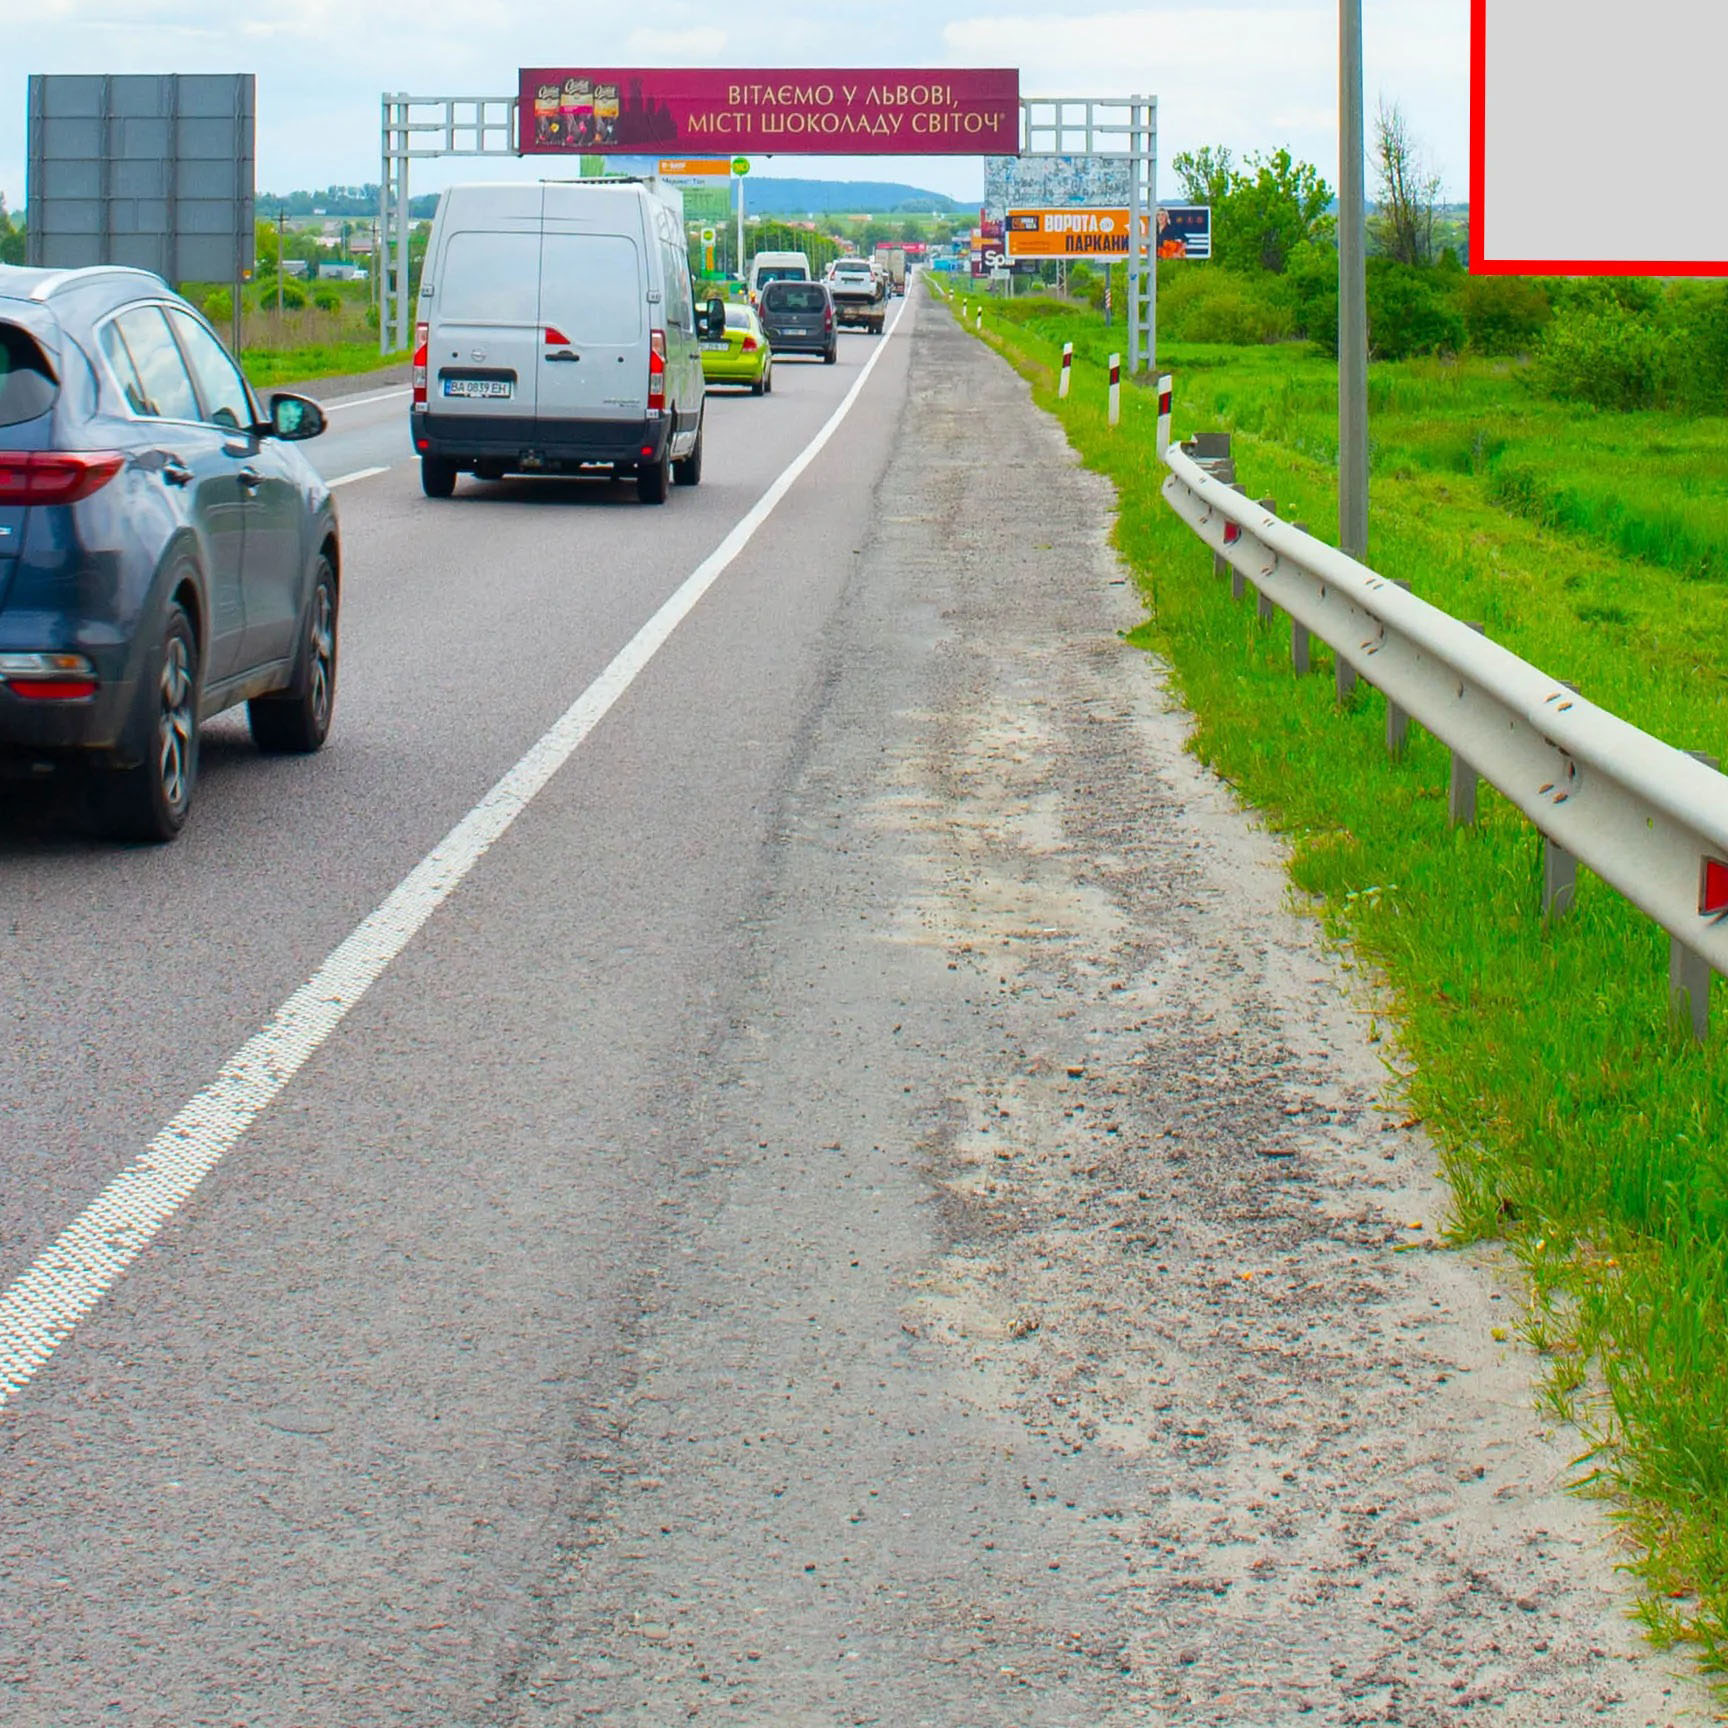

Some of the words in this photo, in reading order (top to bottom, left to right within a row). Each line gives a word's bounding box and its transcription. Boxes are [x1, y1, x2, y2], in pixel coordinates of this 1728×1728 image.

[728, 85, 834, 106] ВІТАЄМО
[842, 85, 858, 106] У
[865, 85, 959, 109] ЛЬВОВІ,
[687, 113, 752, 133] МІСТІ
[761, 113, 904, 137] ШОКОЛАДУ
